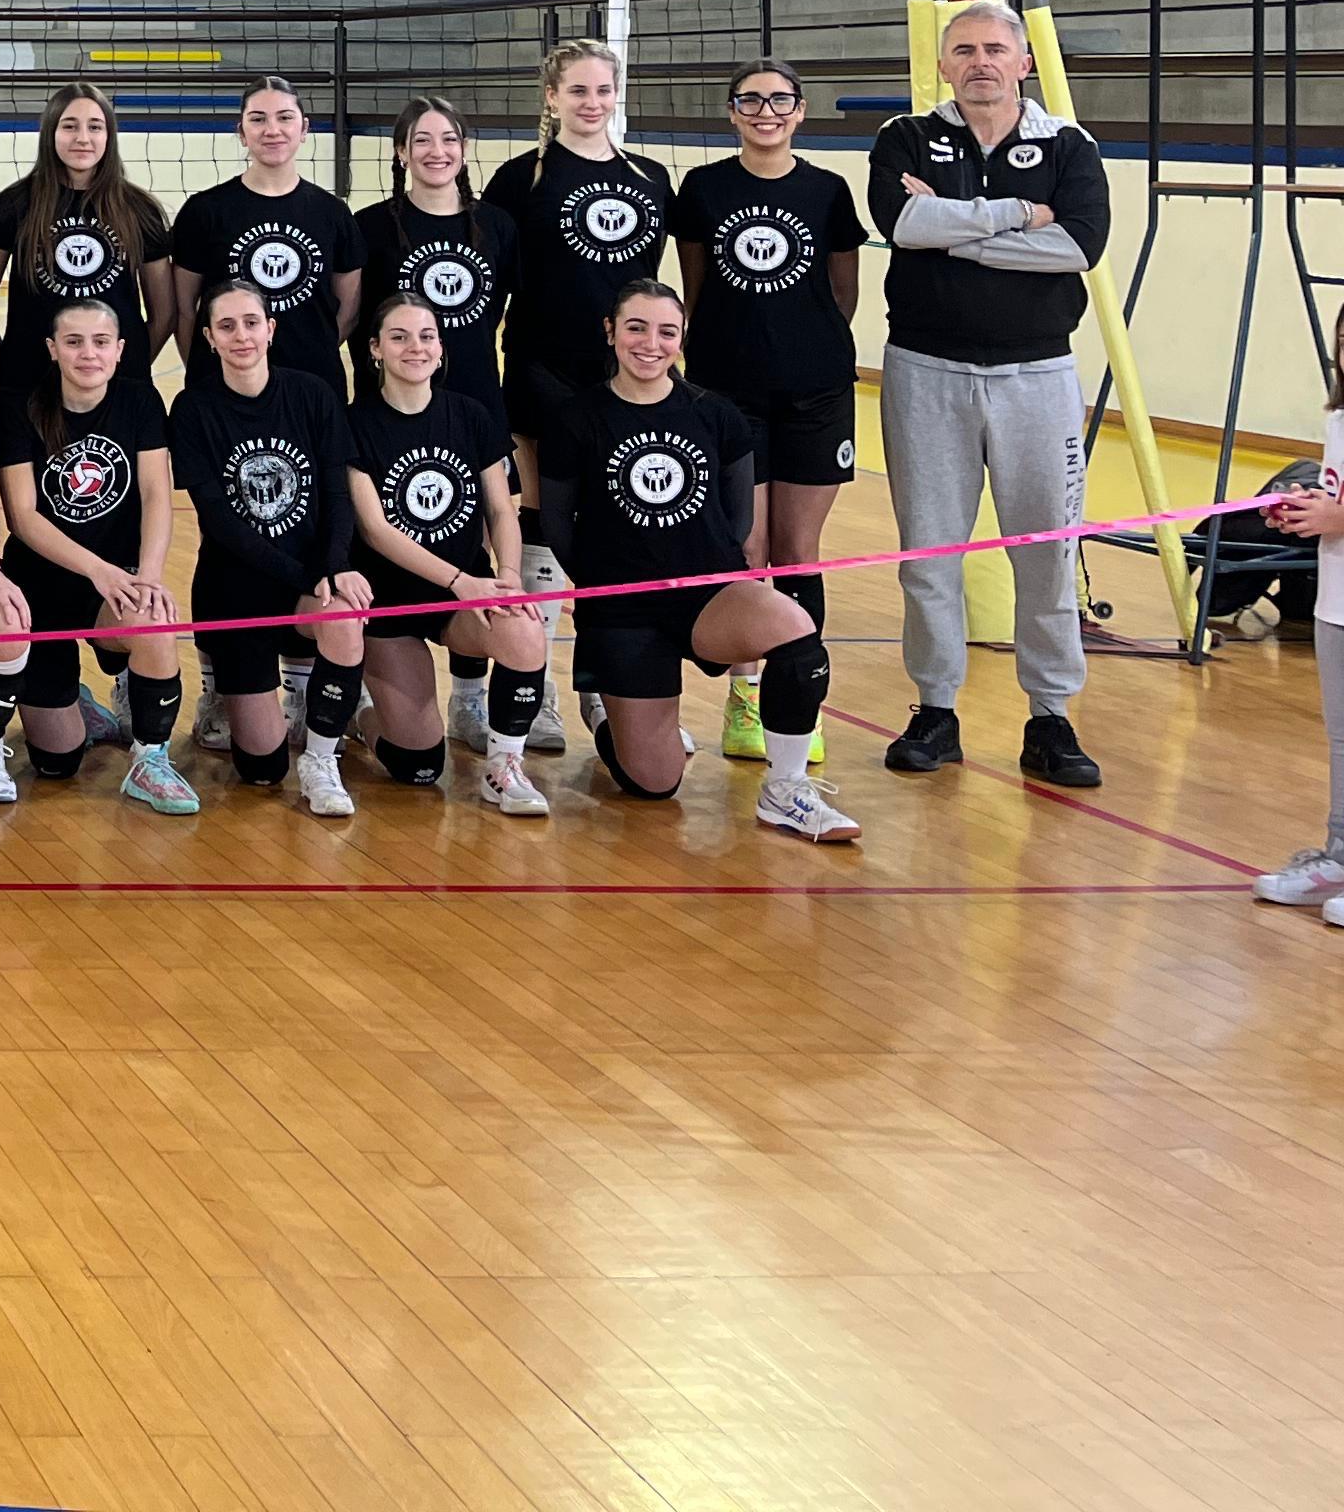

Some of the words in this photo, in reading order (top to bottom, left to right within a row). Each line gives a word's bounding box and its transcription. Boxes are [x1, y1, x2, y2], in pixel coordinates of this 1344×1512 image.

[561, 182, 610, 212] TRESTINA
[616, 183, 657, 211] VOLLEY
[560, 217, 572, 229] 20
[650, 216, 659, 228] 21
[714, 205, 769, 239] TRESTINA
[776, 208, 812, 240] VOLLEY
[229, 222, 279, 257] TRESTINA
[286, 224, 322, 256] VOLLEY
[564, 231, 601, 262] VOLLEY
[608, 230, 656, 263] TRESTINA
[313, 261, 323, 273] 21
[399, 241, 450, 274] TRESTINA
[456, 242, 492, 275] VOLLEY
[398, 279, 410, 290] 20
[755, 259, 812, 293] TRESTINA
[443, 294, 490, 328] TRESTINA
[270, 437, 310, 469] VOLLEY
[606, 431, 657, 473] TRESTINA
[665, 431, 707, 464] VOLLEY
[301, 474, 312, 486] 21
[382, 447, 428, 492] TRESTINA
[433, 446, 472, 479] VOLLEY
[607, 479, 618, 490] 20
[698, 469, 709, 481] 21
[465, 483, 476, 495] 21
[268, 492, 310, 538] TRESTINA
[429, 499, 477, 544] TRESTINA
[657, 485, 707, 528] TRESTINA
